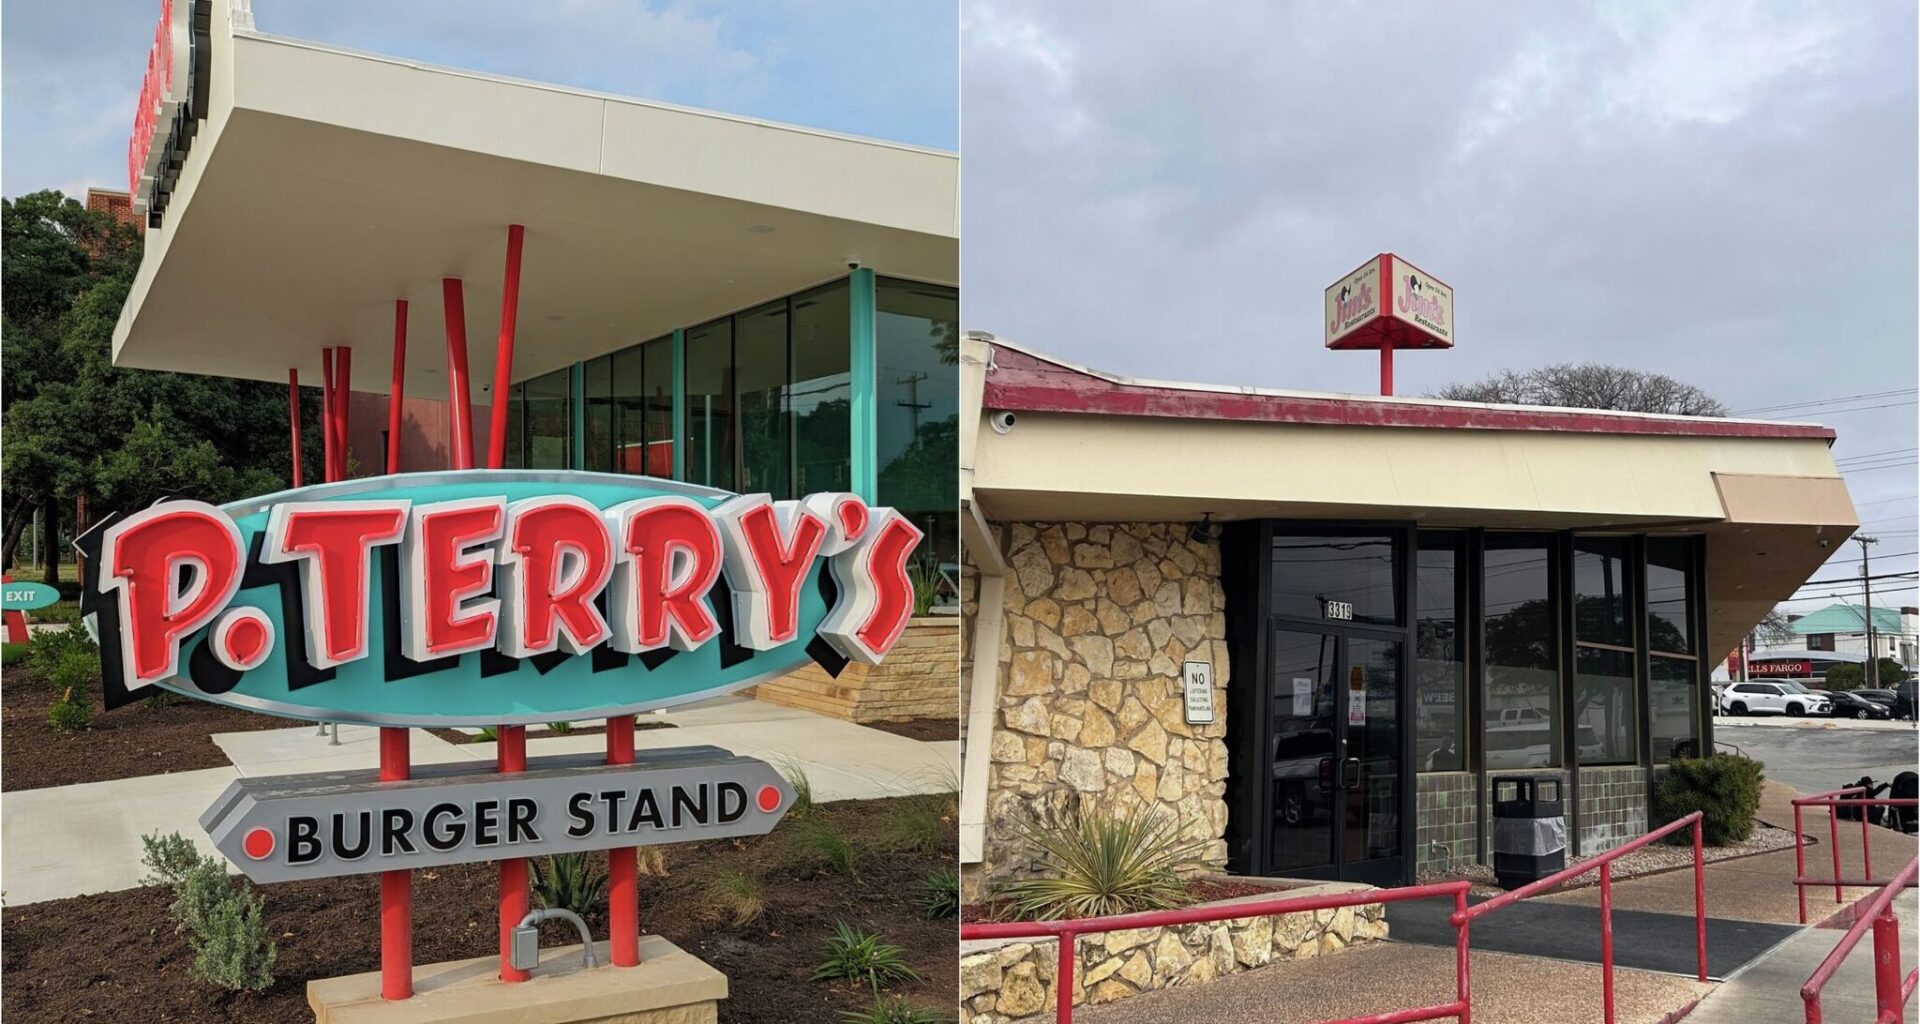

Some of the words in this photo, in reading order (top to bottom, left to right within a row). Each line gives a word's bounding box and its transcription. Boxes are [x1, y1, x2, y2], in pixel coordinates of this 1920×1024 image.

[1330, 282, 1372, 334] Jim's
[1398, 275, 1445, 325] Jim's
[1344, 306, 1375, 330] Restaurants
[1414, 314, 1448, 337] Restaurants
[6, 591, 35, 602] EXIT
[1328, 602, 1352, 619] 3319
[1191, 673, 1205, 685] NO
[1770, 664, 1802, 673] FARGO
[286, 797, 541, 865] BURGER
[564, 780, 749, 839] STAND
